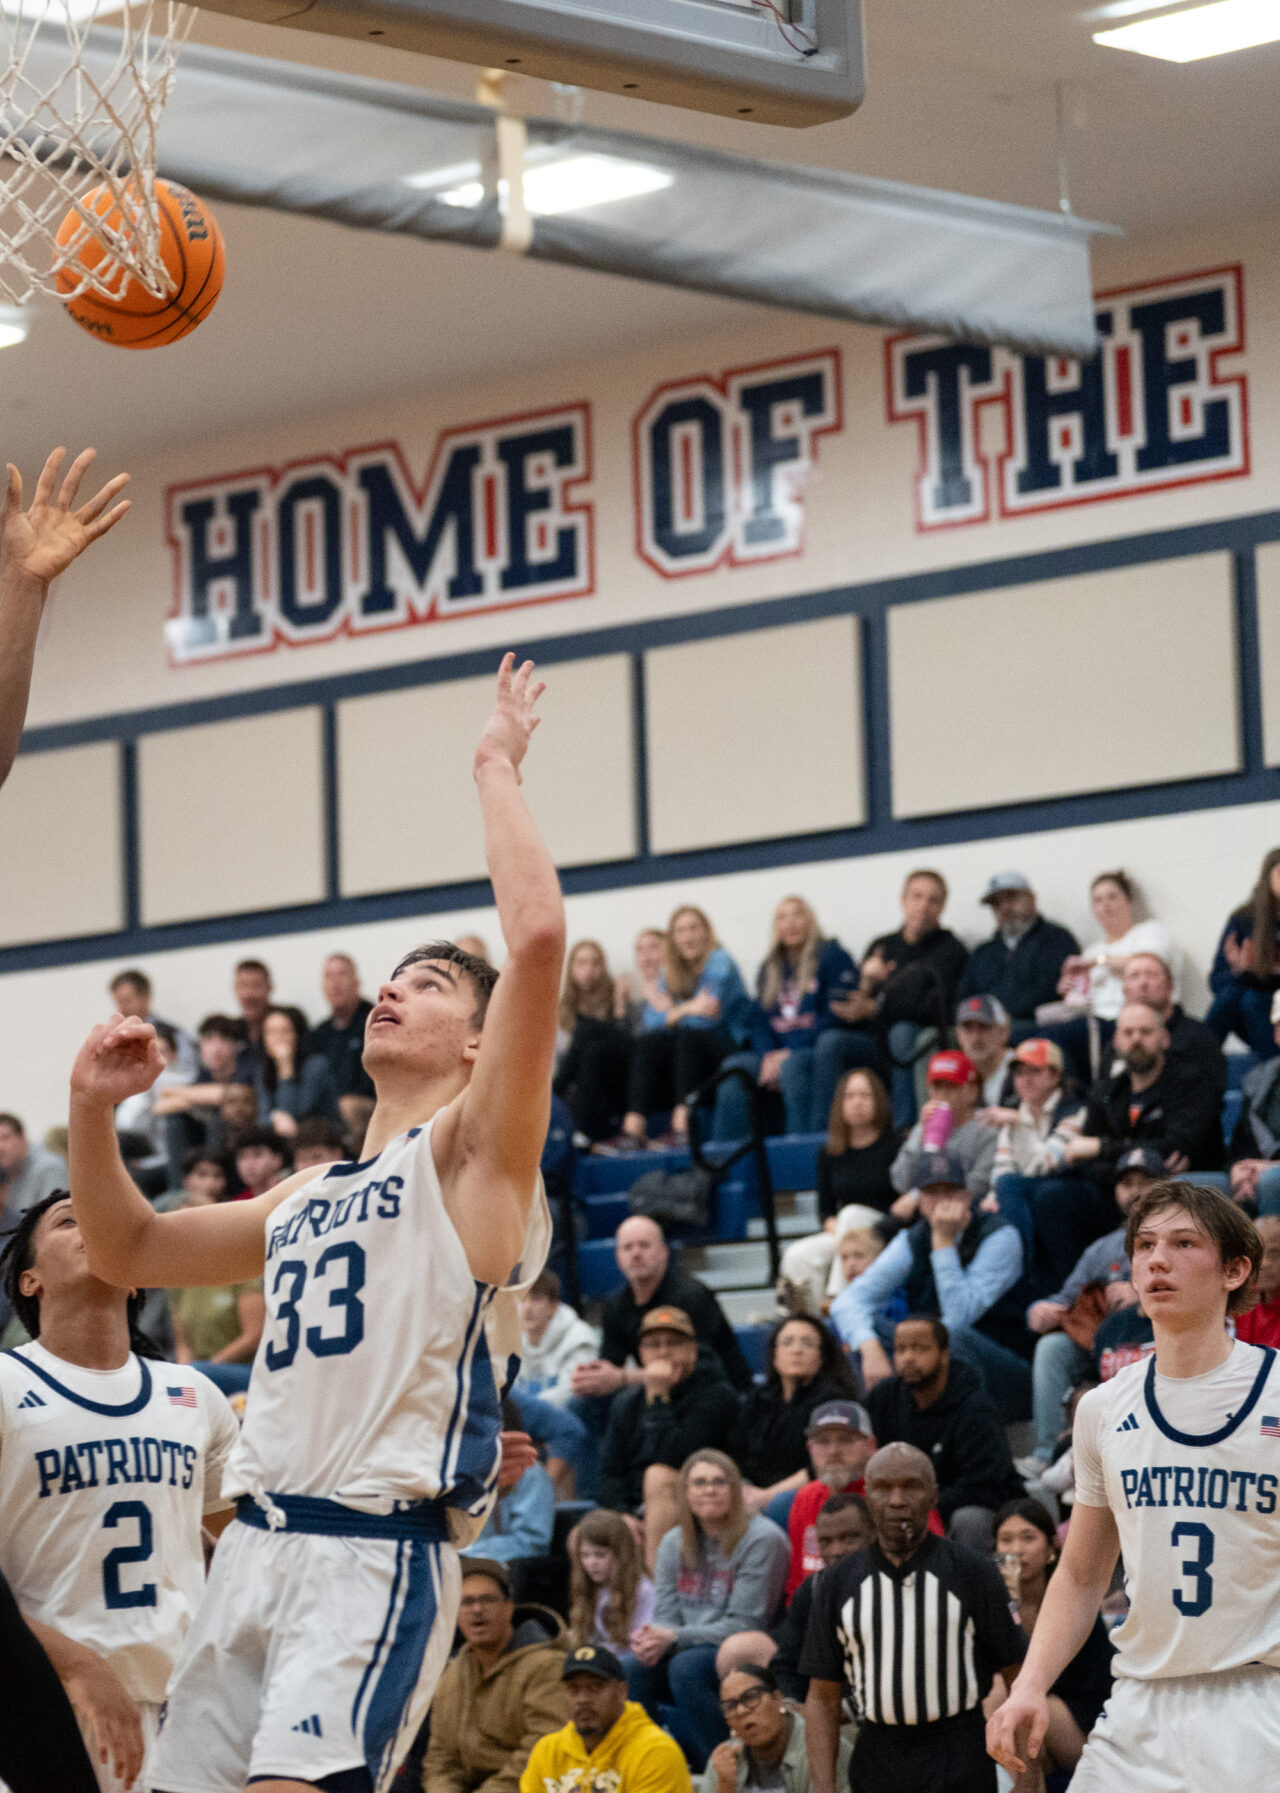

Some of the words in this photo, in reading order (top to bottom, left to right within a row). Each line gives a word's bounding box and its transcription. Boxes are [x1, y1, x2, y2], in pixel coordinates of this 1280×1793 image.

[170, 407, 590, 663] HOME
[636, 352, 839, 573] OF
[890, 270, 1245, 527] THE
[265, 1241, 366, 1372] 33
[35, 1437, 197, 1498] PATRIOTS
[1120, 1466, 1278, 1514] PATRIOTS
[103, 1500, 157, 1609] 2
[1171, 1521, 1214, 1617] 3
